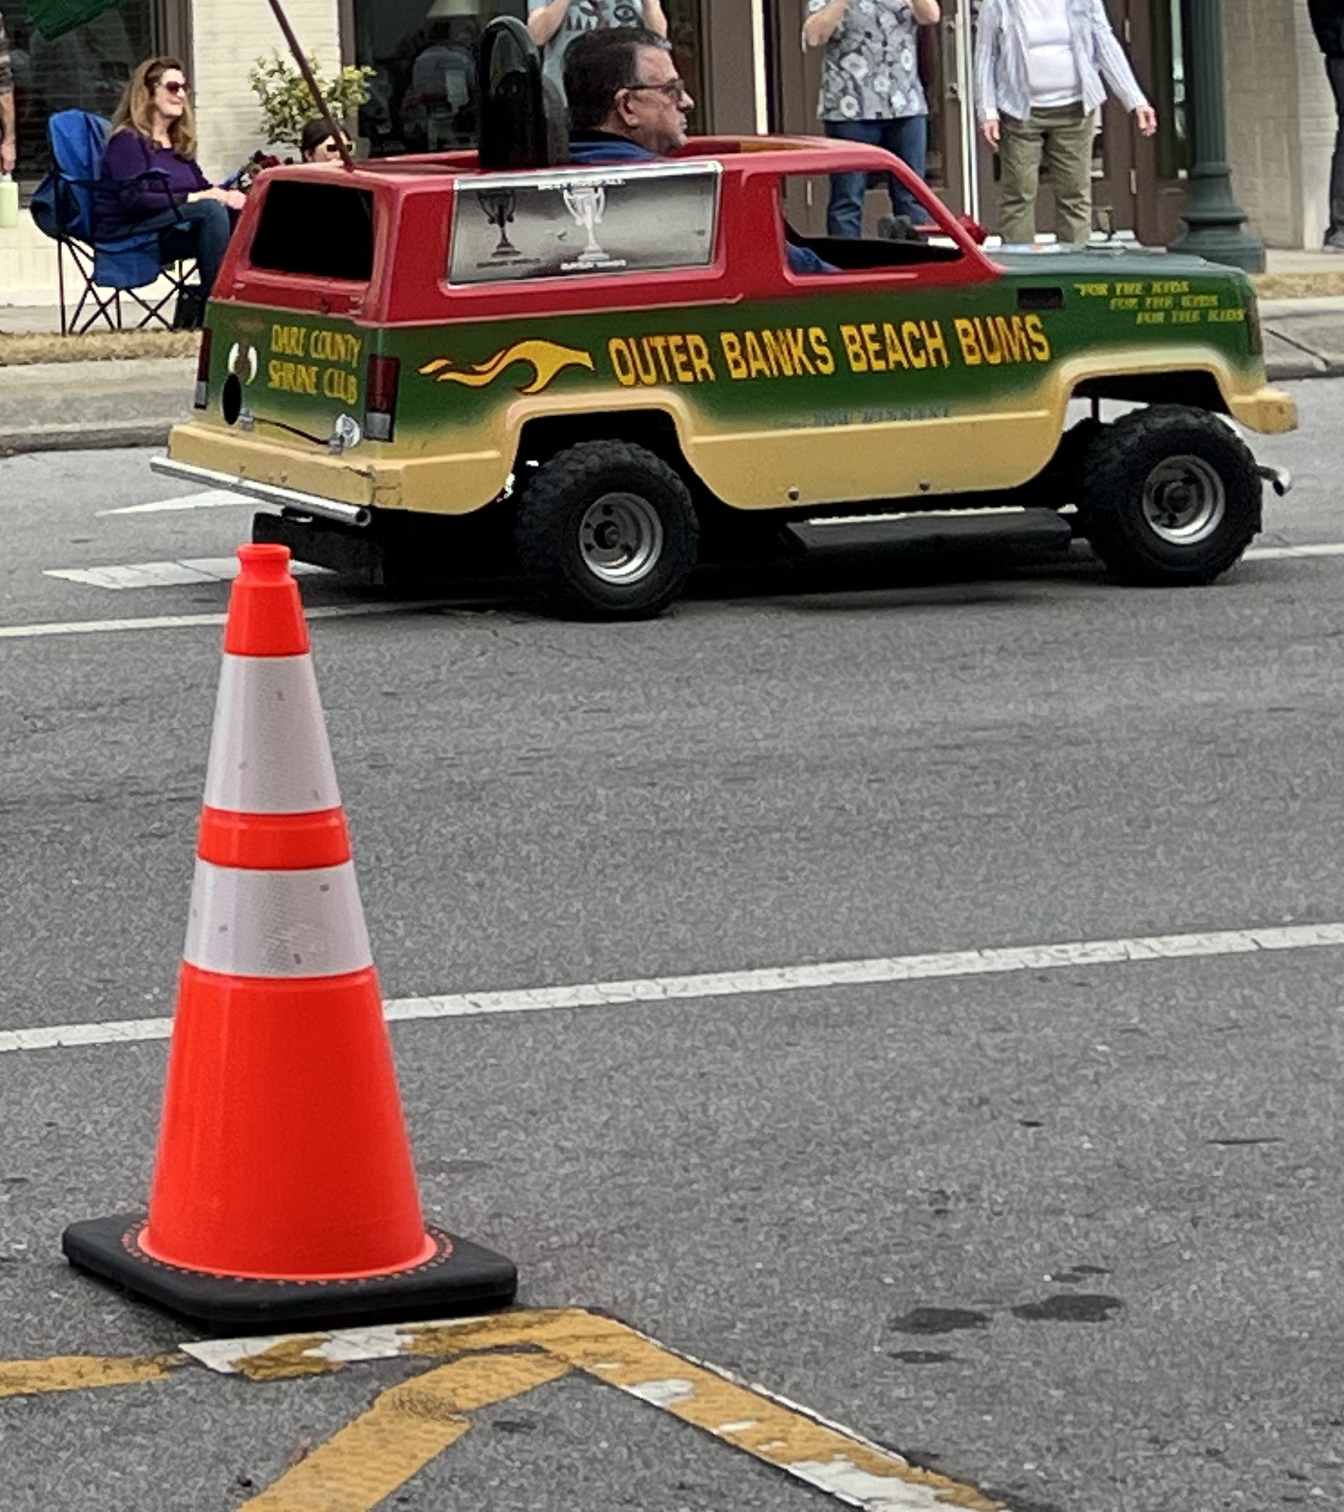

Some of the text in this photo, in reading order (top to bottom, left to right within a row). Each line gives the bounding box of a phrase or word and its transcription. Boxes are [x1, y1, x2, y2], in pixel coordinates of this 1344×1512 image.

[271, 324, 362, 368] DARE COUNTY
[607, 313, 1052, 388] OUTER BANKS BEACH BUMS
[267, 359, 358, 405] SHRINE CLUB
